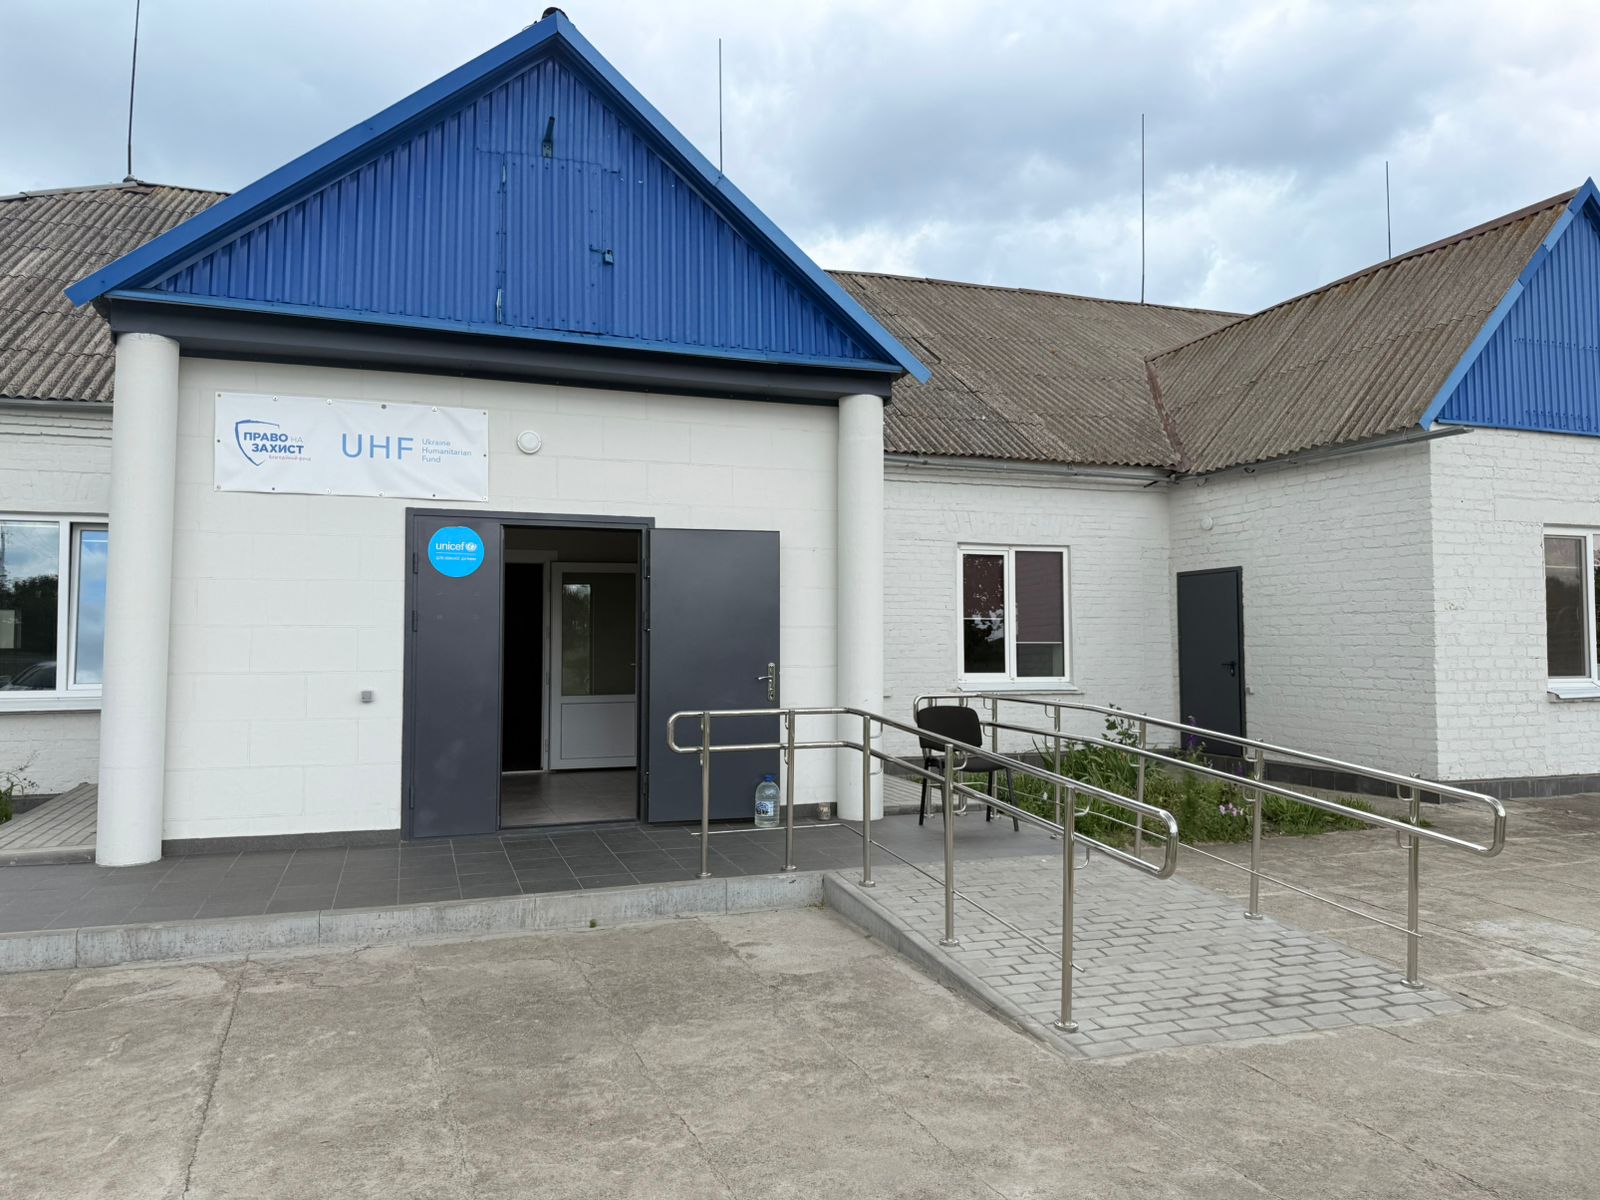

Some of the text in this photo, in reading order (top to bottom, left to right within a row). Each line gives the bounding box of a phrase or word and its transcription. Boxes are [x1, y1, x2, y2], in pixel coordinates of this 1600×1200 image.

[243, 432, 288, 443] ПРАВО
[422, 438, 451, 447] Ukraine
[252, 443, 304, 454] ЗАХИСТ
[342, 433, 414, 459] UHF
[422, 447, 472, 457] Humanitarian
[422, 455, 441, 464] Fund
[435, 541, 465, 551] unicef
